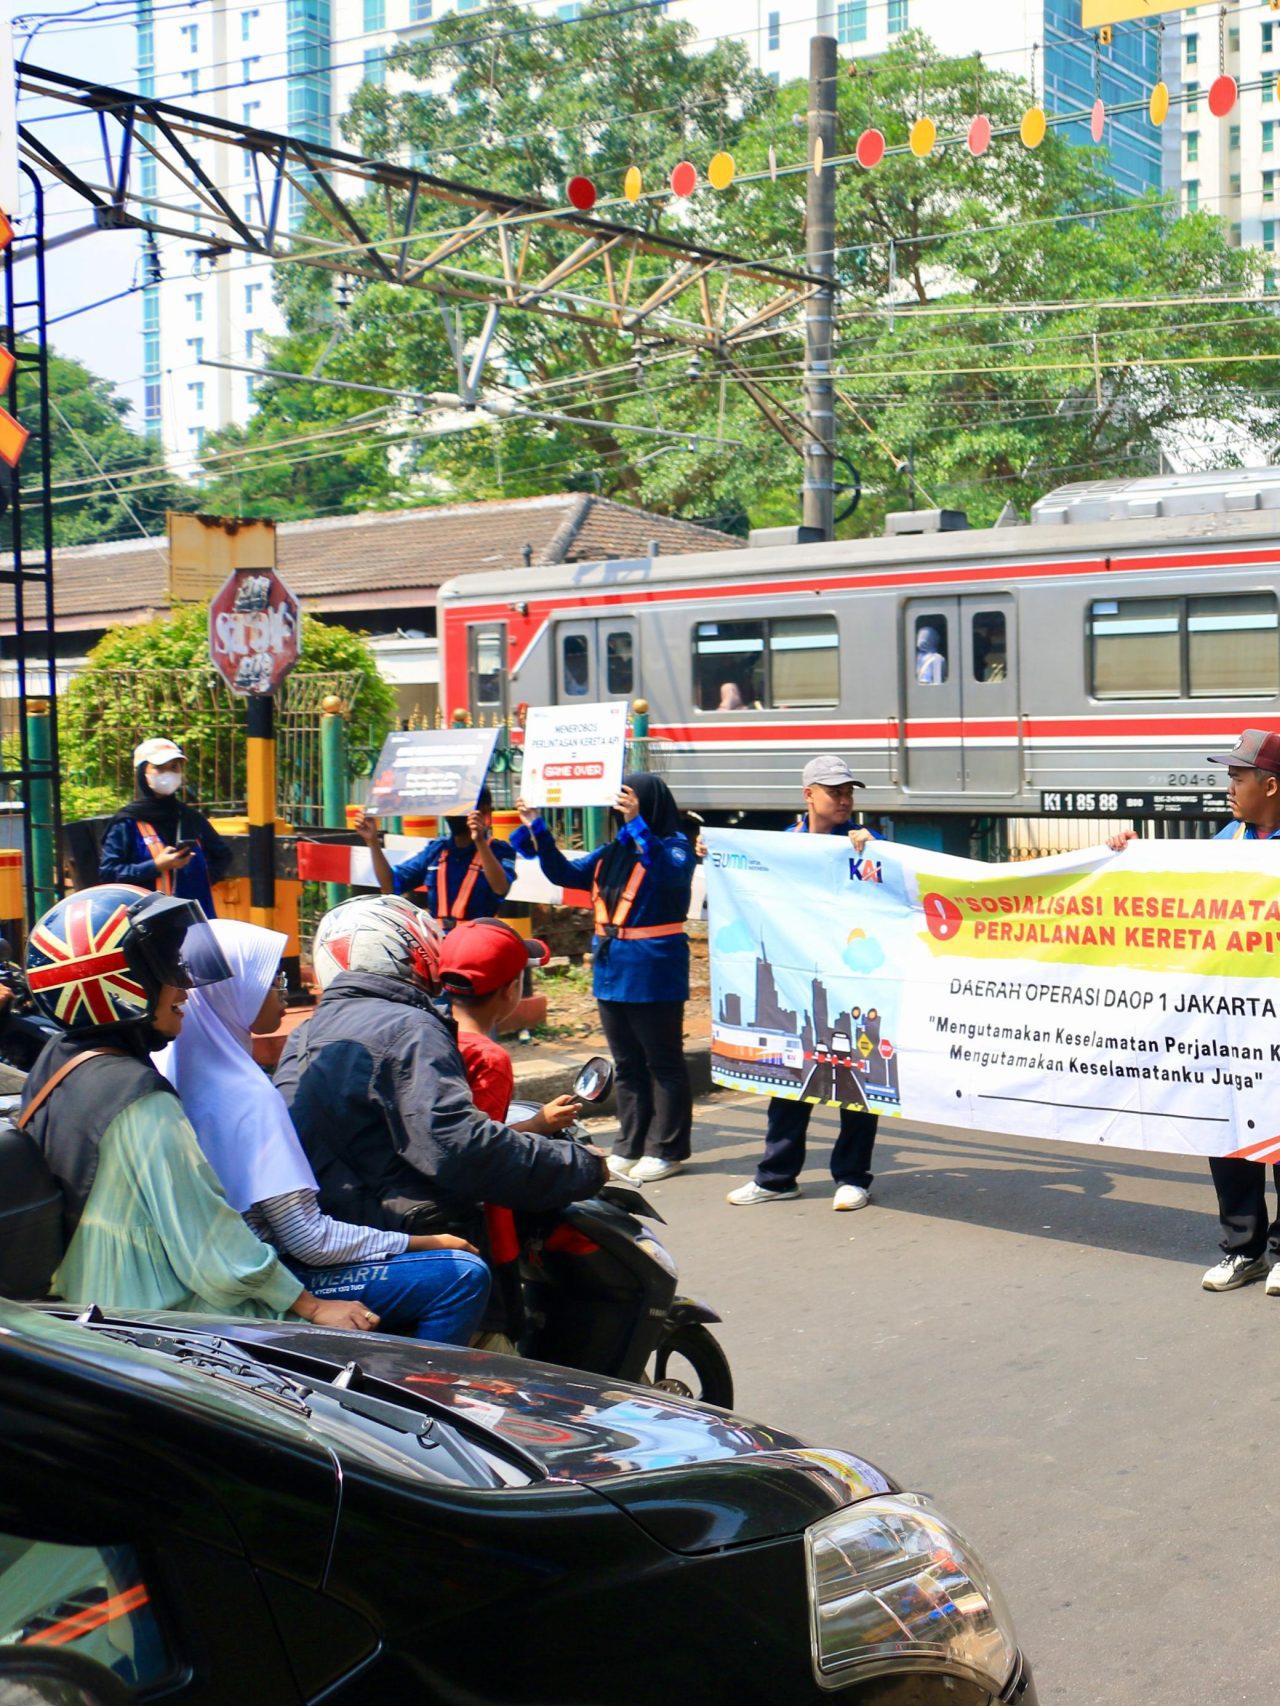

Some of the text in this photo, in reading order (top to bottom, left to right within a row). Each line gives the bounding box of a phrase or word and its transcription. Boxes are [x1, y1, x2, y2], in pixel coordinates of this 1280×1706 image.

[580, 736, 607, 747] KERETA
[544, 764, 603, 777] GAME OVER
[1168, 774, 1216, 787] 204-6
[1064, 793, 1073, 811] 1
[1076, 793, 1096, 811] 85
[1099, 793, 1118, 811] 88
[849, 857, 883, 883] KAI
[954, 896, 1102, 916] "SOSIALISASI
[974, 921, 1116, 946] PERJALANAN
[1125, 927, 1217, 950] KERETA
[950, 978, 1277, 1018] DAERAH OPERASI DAOP 1 JAKARTA
[929, 1016, 1051, 1043] "Mengutamakan
[1055, 1027, 1159, 1053] Keselamatan
[1165, 1036, 1263, 1060] Perjalanan
[950, 1045, 1263, 1091] Mengutamakan Keselamatanku Juga"
